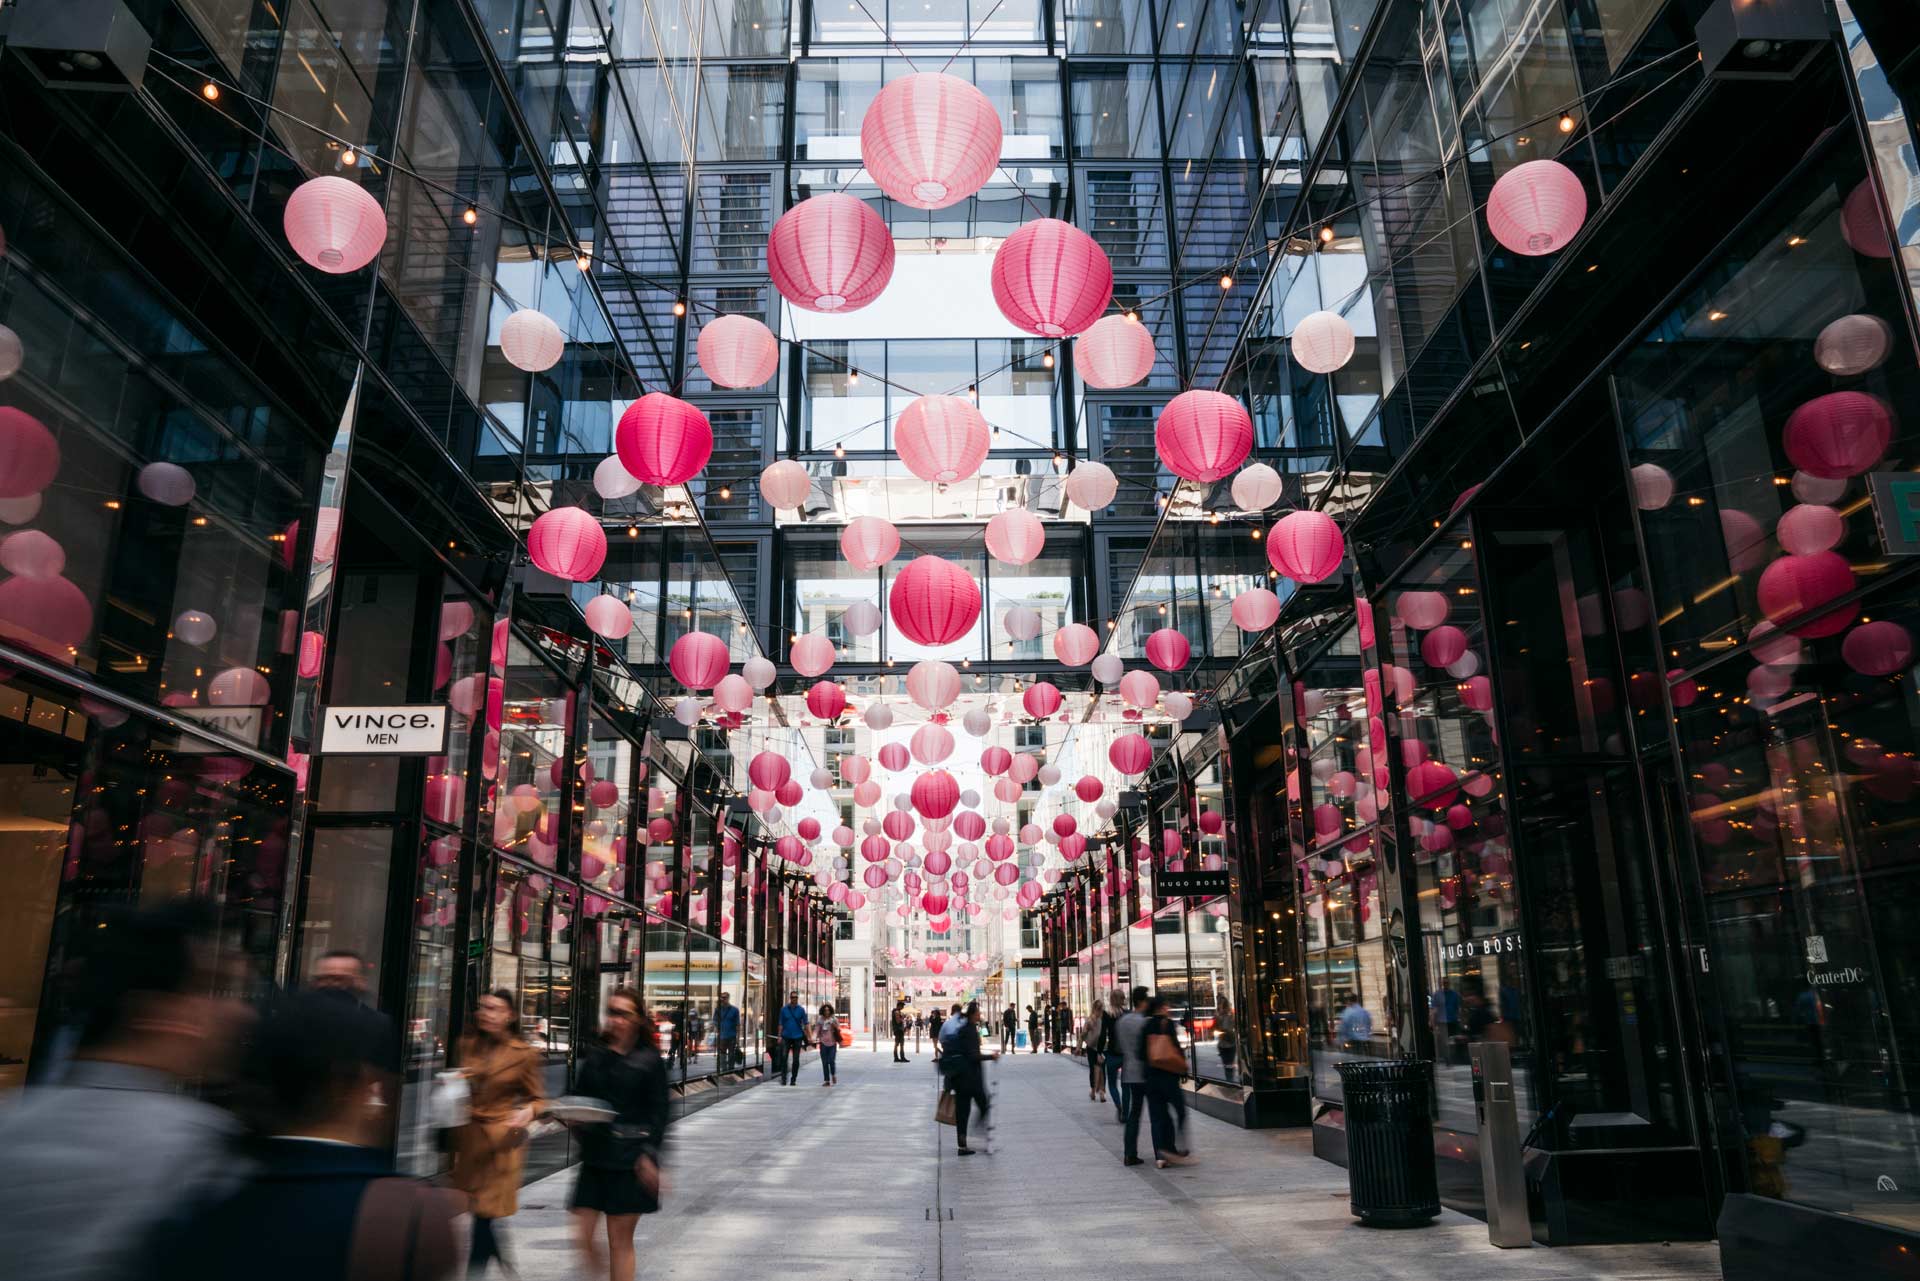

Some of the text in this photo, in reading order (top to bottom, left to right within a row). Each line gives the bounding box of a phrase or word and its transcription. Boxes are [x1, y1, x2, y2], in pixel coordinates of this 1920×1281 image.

[366, 733, 399, 745] MEN
[1440, 942, 1474, 960] HUGO
[1806, 967, 1864, 985] CenterDC
